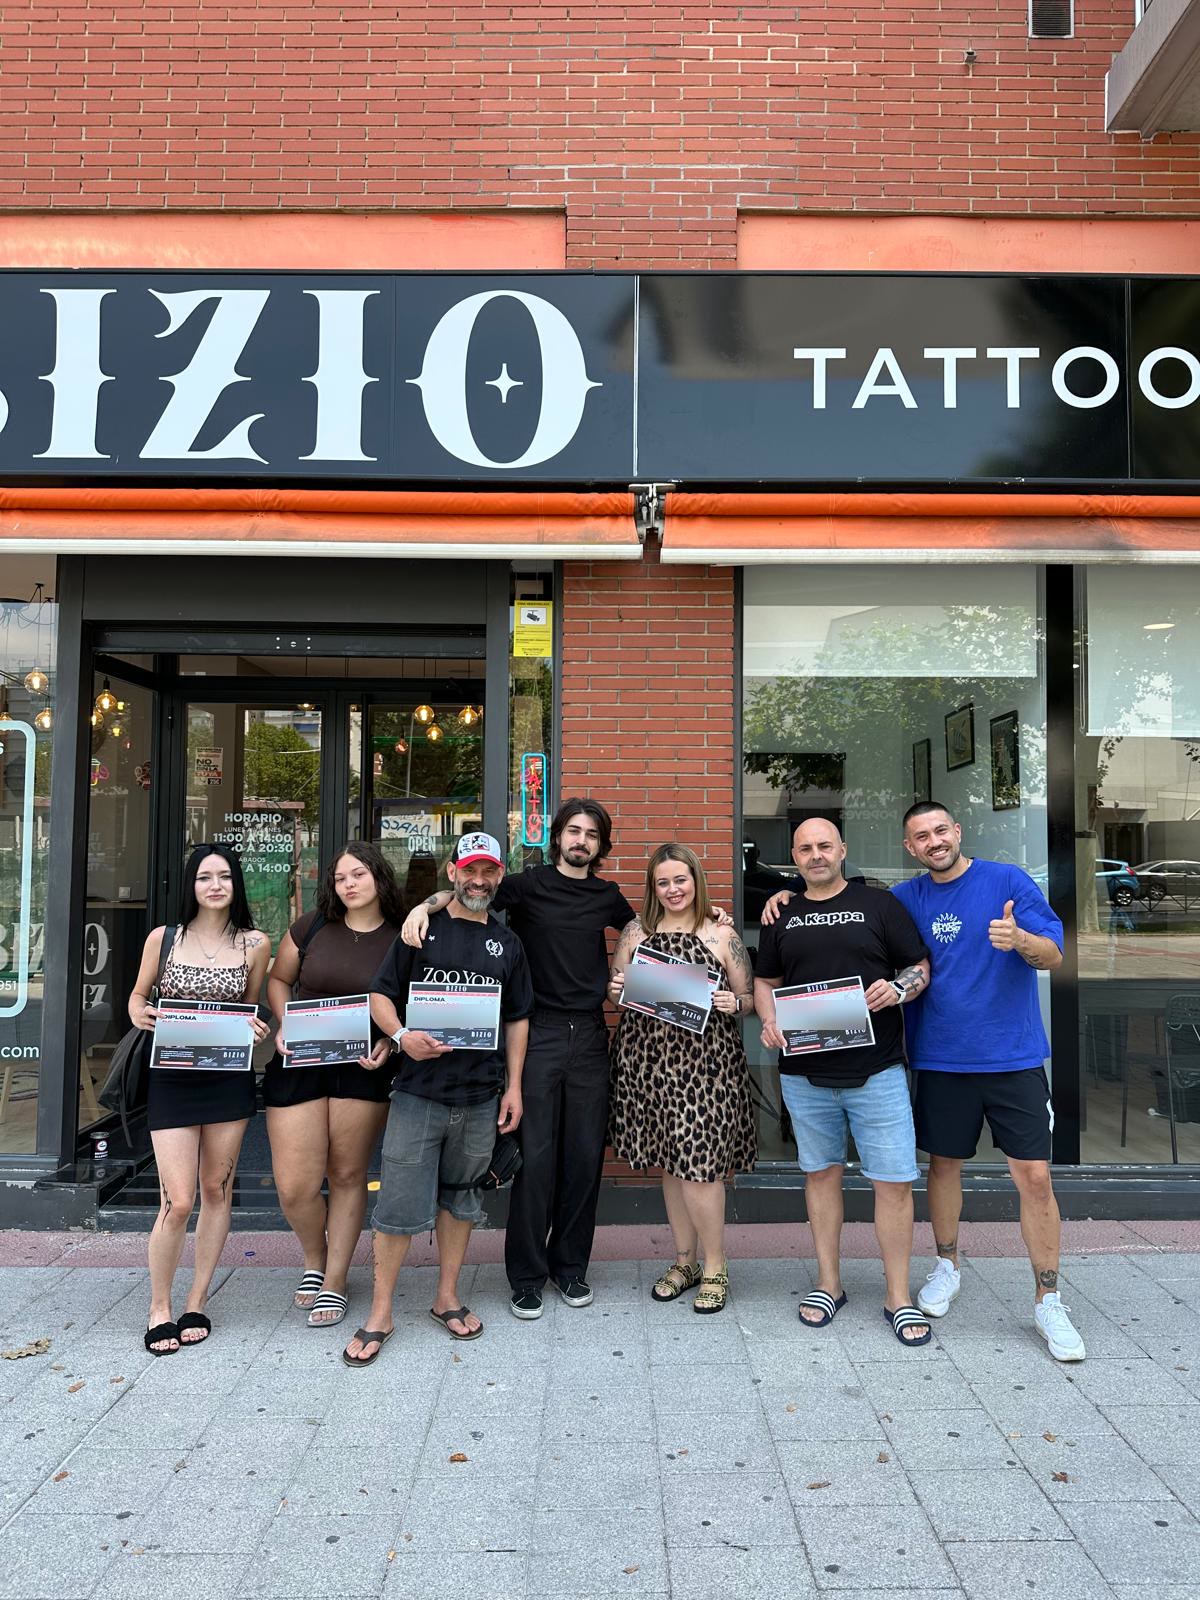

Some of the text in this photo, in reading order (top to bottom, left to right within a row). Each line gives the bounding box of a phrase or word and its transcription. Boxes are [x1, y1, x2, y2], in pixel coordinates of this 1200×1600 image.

[0, 288, 604, 468] IZIO
[793, 346, 1200, 410] TATTOO
[224, 813, 282, 822] HORARIO
[213, 833, 292, 843] 11:00 A 14:00
[246, 844, 255, 852] A
[258, 844, 293, 852] 20:30
[408, 836, 436, 852] OPEN
[245, 864, 291, 872] A 14:00
[806, 911, 864, 925] Kappa
[423, 967, 460, 984] ZOO
[197, 1003, 221, 1011] BIZIO
[319, 999, 340, 1008] BIZIO
[681, 1009, 702, 1020] BIZIO
[346, 1042, 365, 1050] BIZIO
